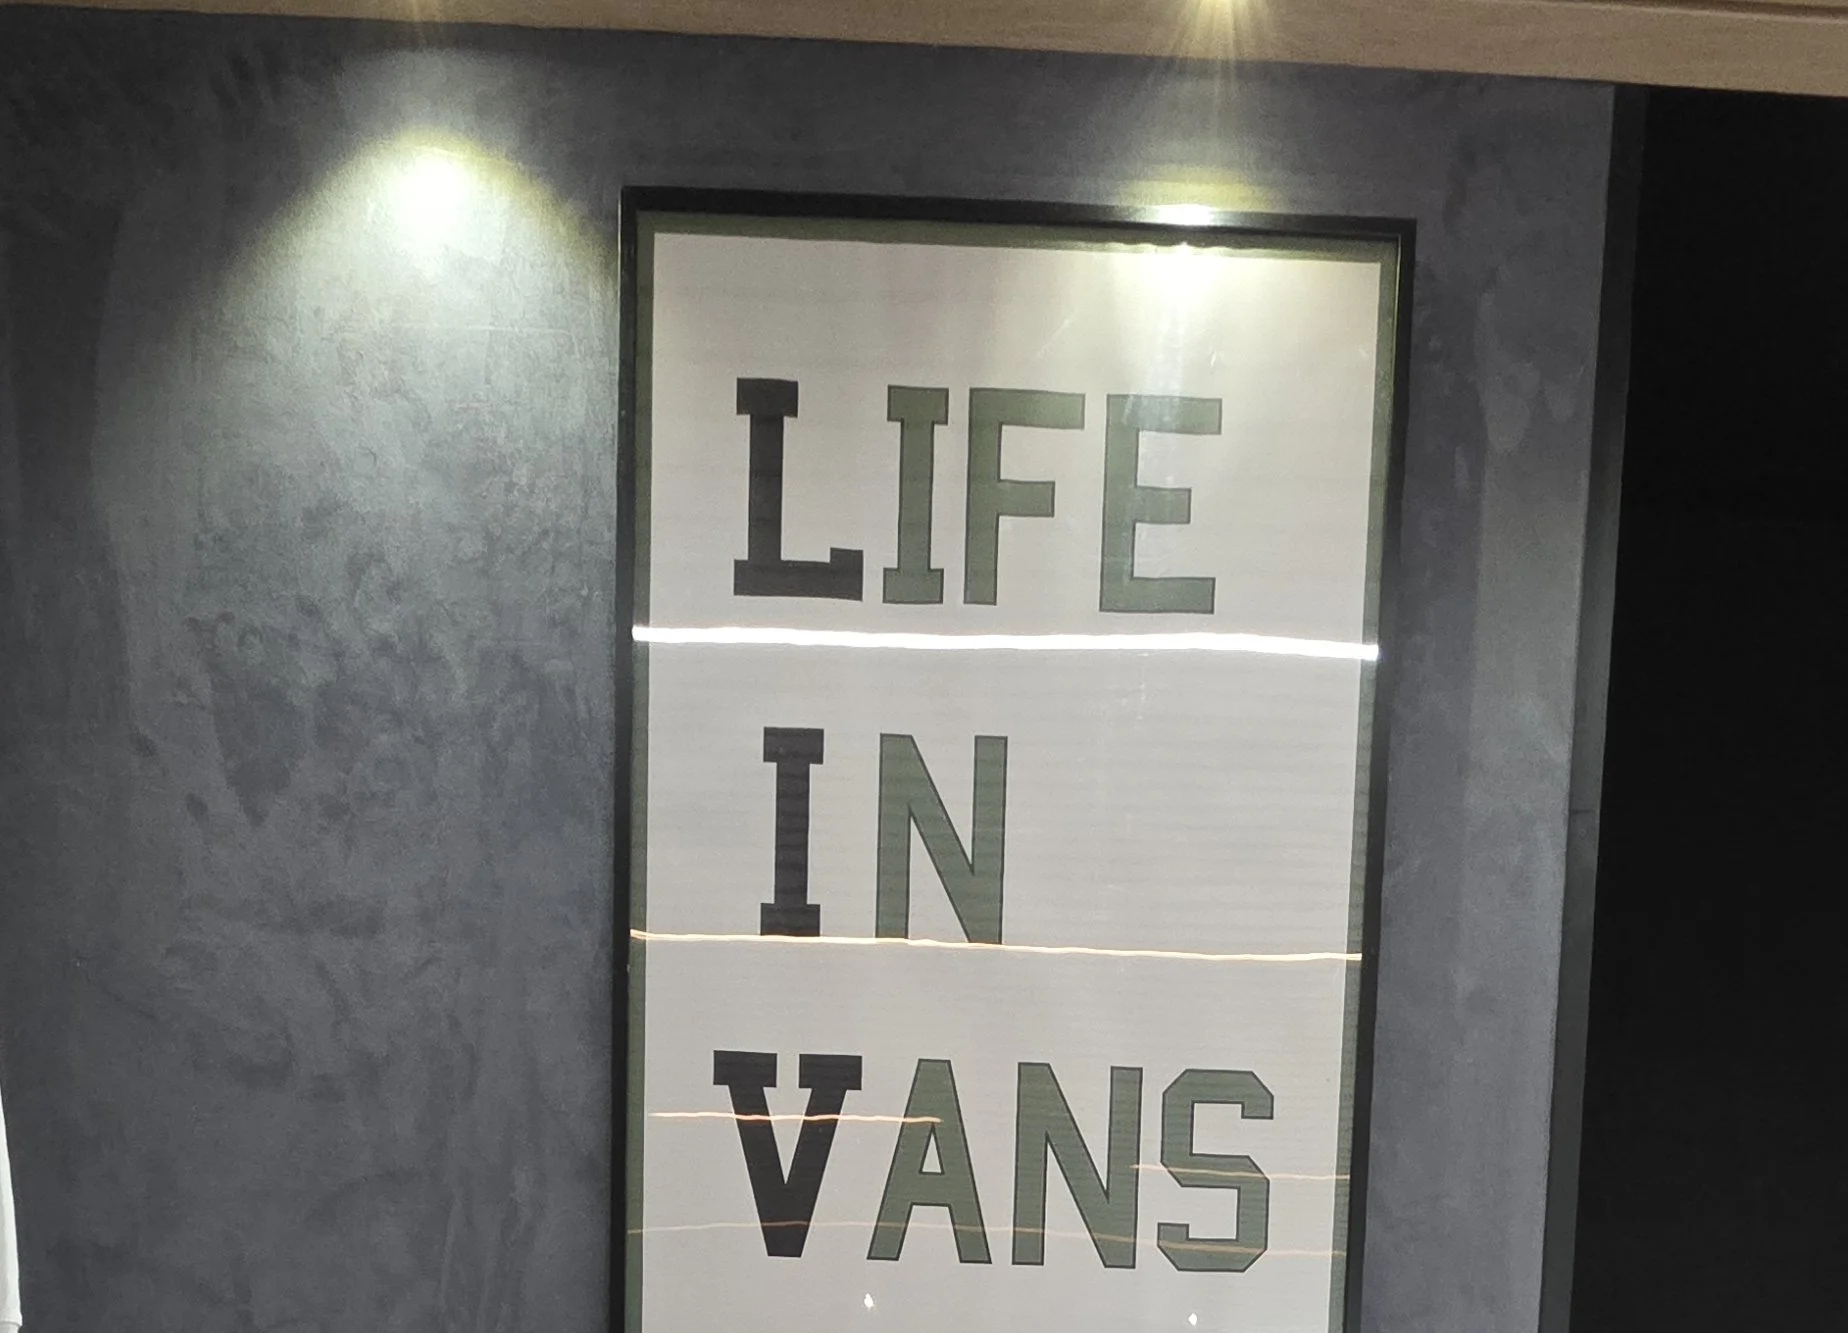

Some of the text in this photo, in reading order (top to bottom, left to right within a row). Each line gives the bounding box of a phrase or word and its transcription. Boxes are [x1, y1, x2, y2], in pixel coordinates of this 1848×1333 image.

[735, 377, 1222, 613] LIFE
[760, 728, 1008, 945] IN
[713, 1050, 1274, 1273] VANS
